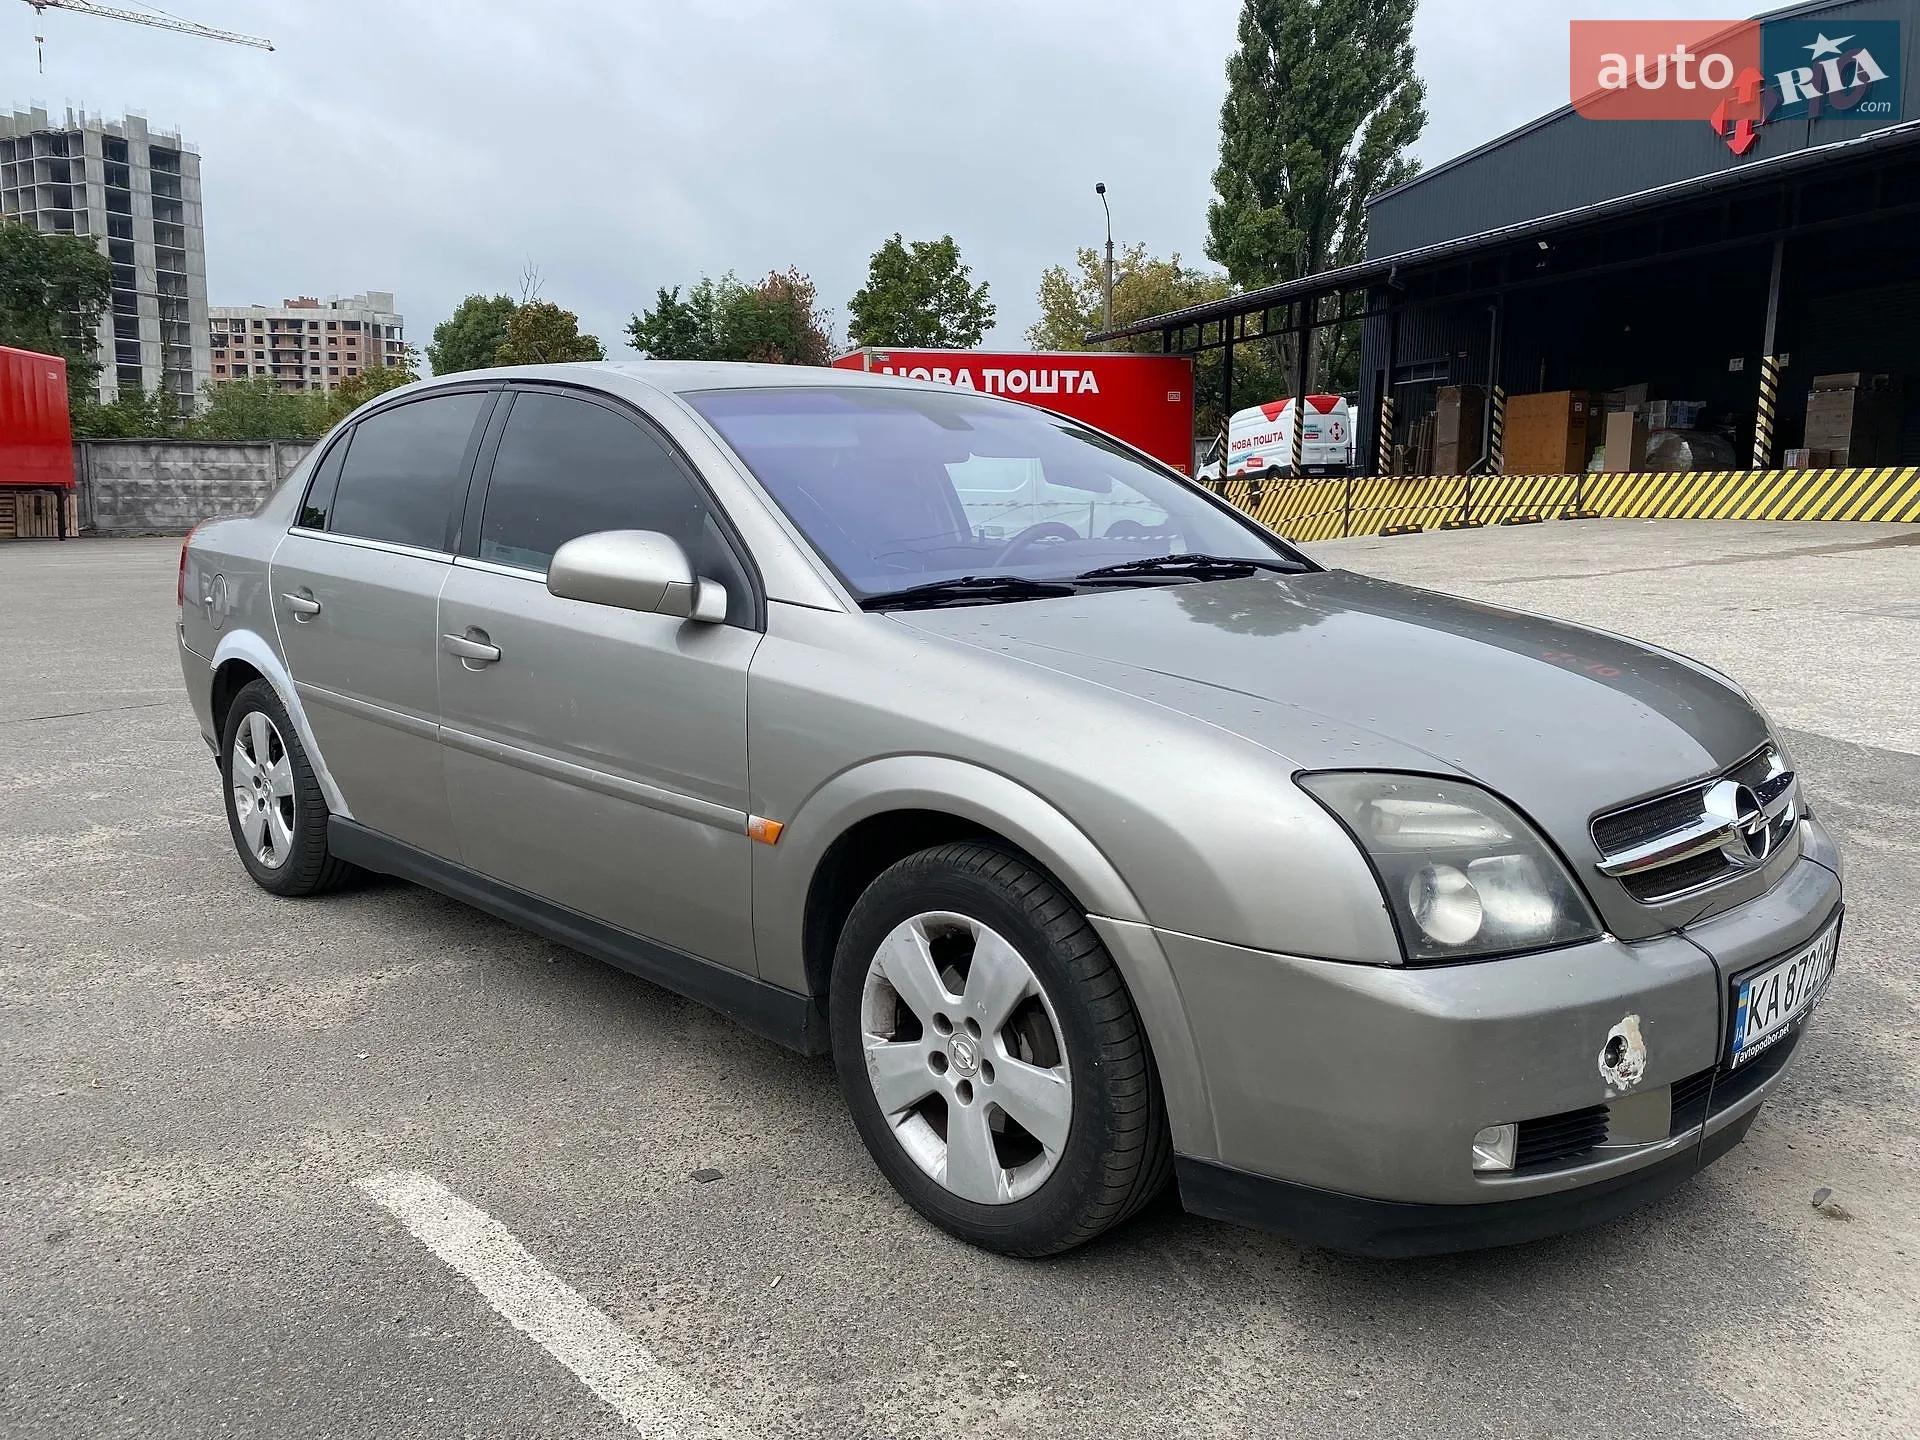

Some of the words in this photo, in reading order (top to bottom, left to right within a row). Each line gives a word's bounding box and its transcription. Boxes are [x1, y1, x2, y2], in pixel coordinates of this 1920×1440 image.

[882, 366, 976, 391] ОВА
[982, 368, 1100, 394] ПОШТА
[1231, 438, 1252, 451] НОВА
[1253, 431, 1284, 446] ПОШТА
[1746, 973, 1780, 1037] KA
[1739, 1022, 1791, 1063] avtopodbor.net
